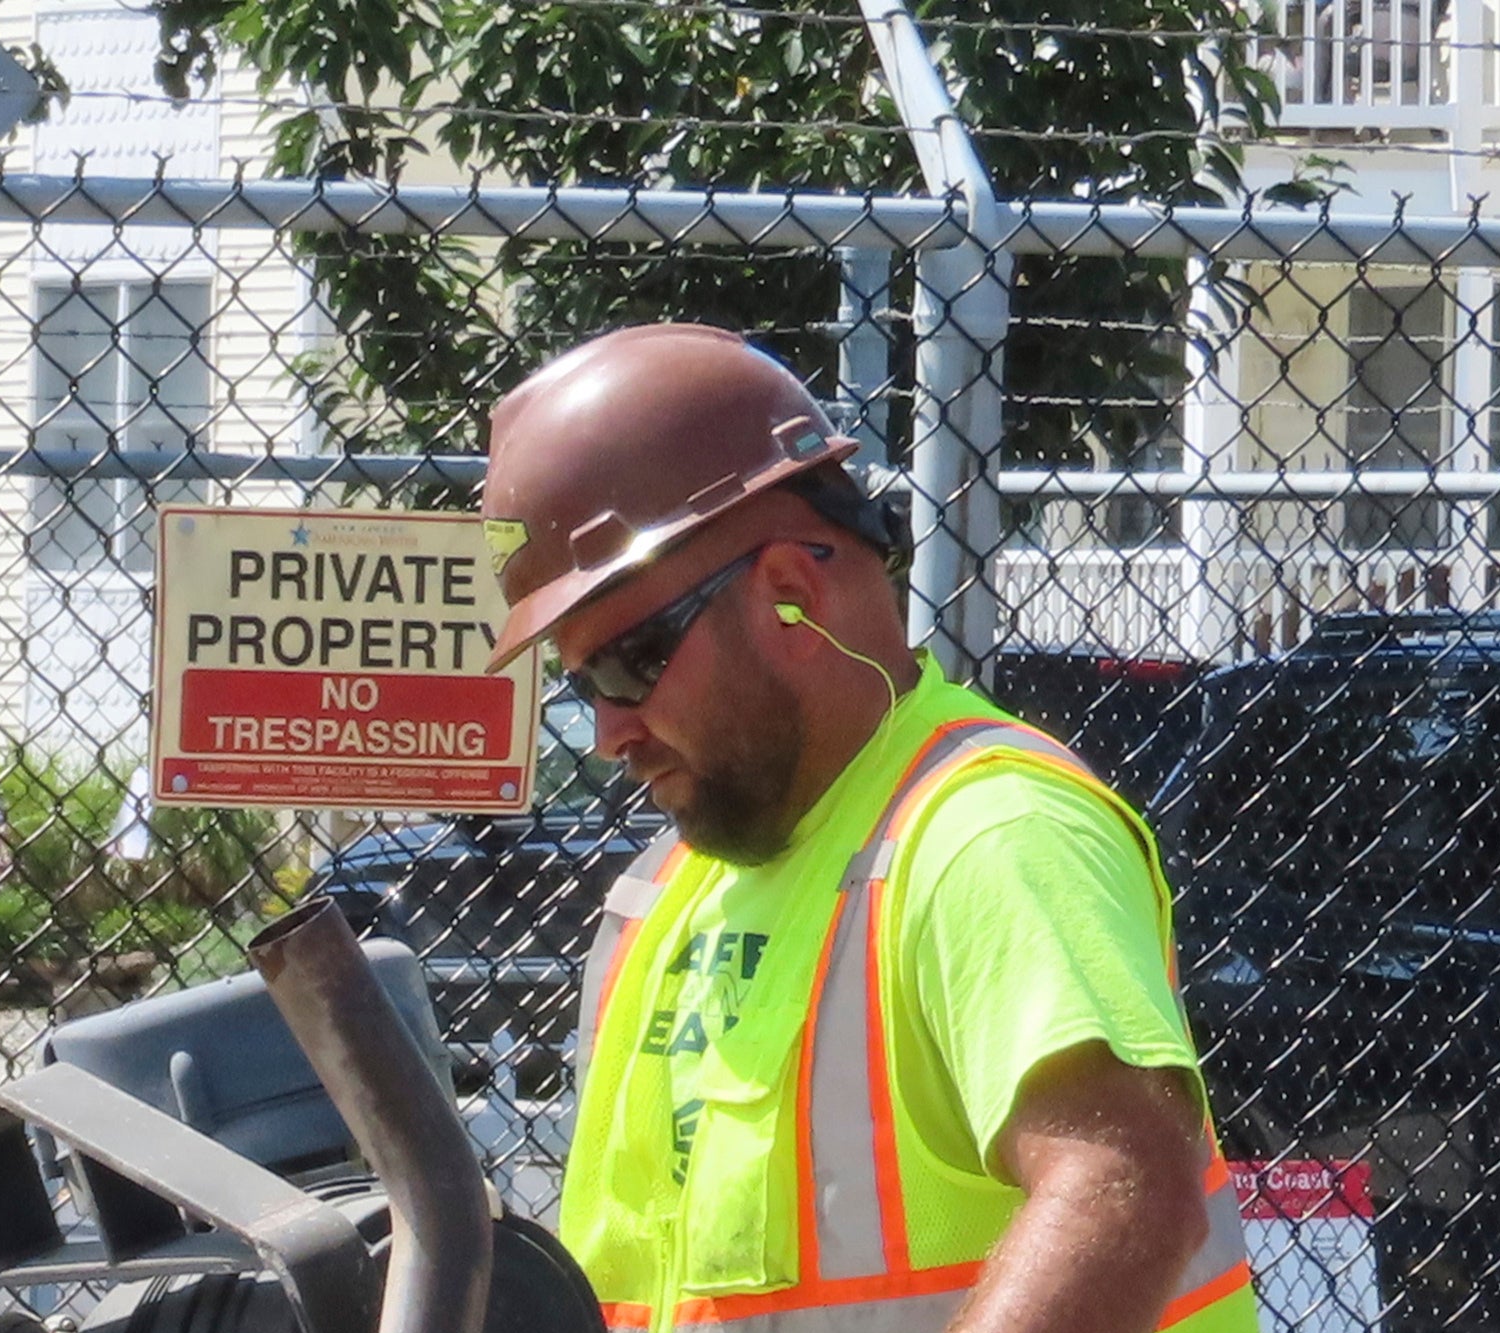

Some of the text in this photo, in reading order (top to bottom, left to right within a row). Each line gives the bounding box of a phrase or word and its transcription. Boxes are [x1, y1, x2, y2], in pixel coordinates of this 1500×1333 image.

[230, 551, 475, 605] PRIVATE
[321, 677, 379, 712] NO
[208, 716, 487, 756] TRESPASSING
[1266, 1166, 1332, 1191] Coast
